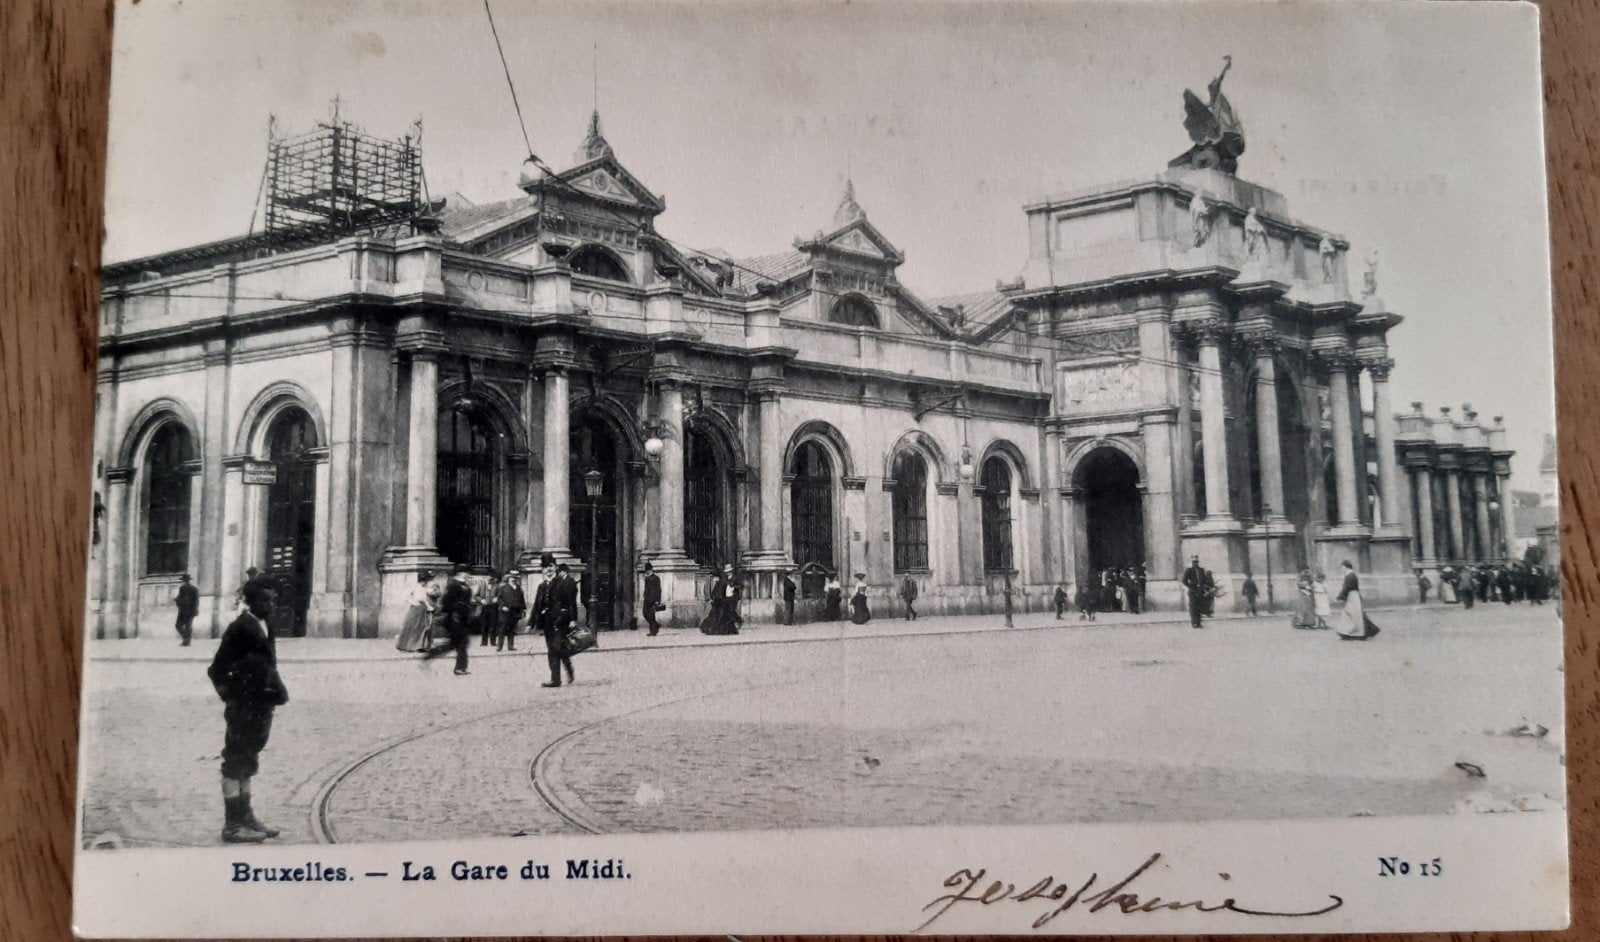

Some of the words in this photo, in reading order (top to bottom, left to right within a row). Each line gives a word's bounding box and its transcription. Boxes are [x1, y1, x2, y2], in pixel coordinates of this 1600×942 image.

[231, 861, 354, 883] Bruxelles.
[401, 861, 437, 882] La
[450, 860, 508, 882] Gare
[520, 859, 551, 881] du
[565, 858, 632, 880] Midi.
[1420, 857, 1442, 877] 15
